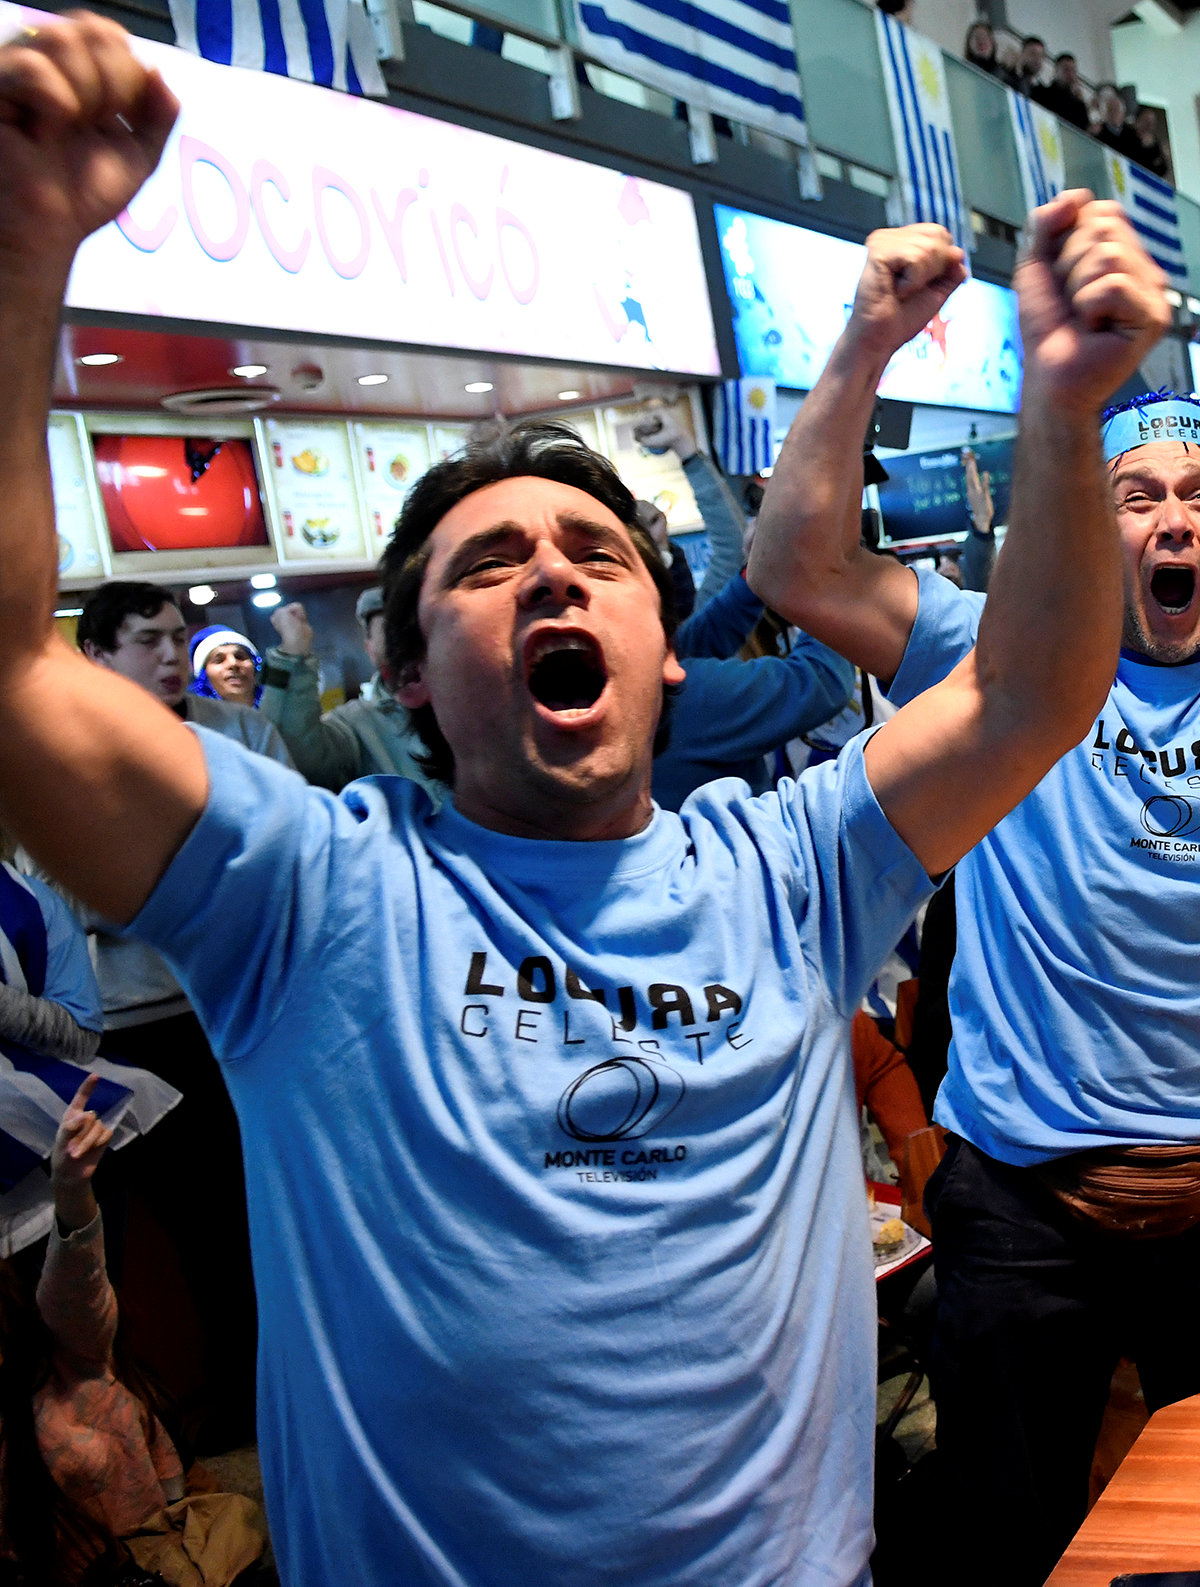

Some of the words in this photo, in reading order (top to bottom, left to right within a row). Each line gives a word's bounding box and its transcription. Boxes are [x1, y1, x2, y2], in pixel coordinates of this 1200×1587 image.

[1129, 837, 1171, 852] MONTE
[1147, 851, 1196, 862] TELEVISIÓN
[464, 951, 743, 1032] LOCURA
[544, 1151, 616, 1169] MONTE
[620, 1145, 687, 1166] CARLO
[576, 1168, 658, 1184] TELEVISIÓN
